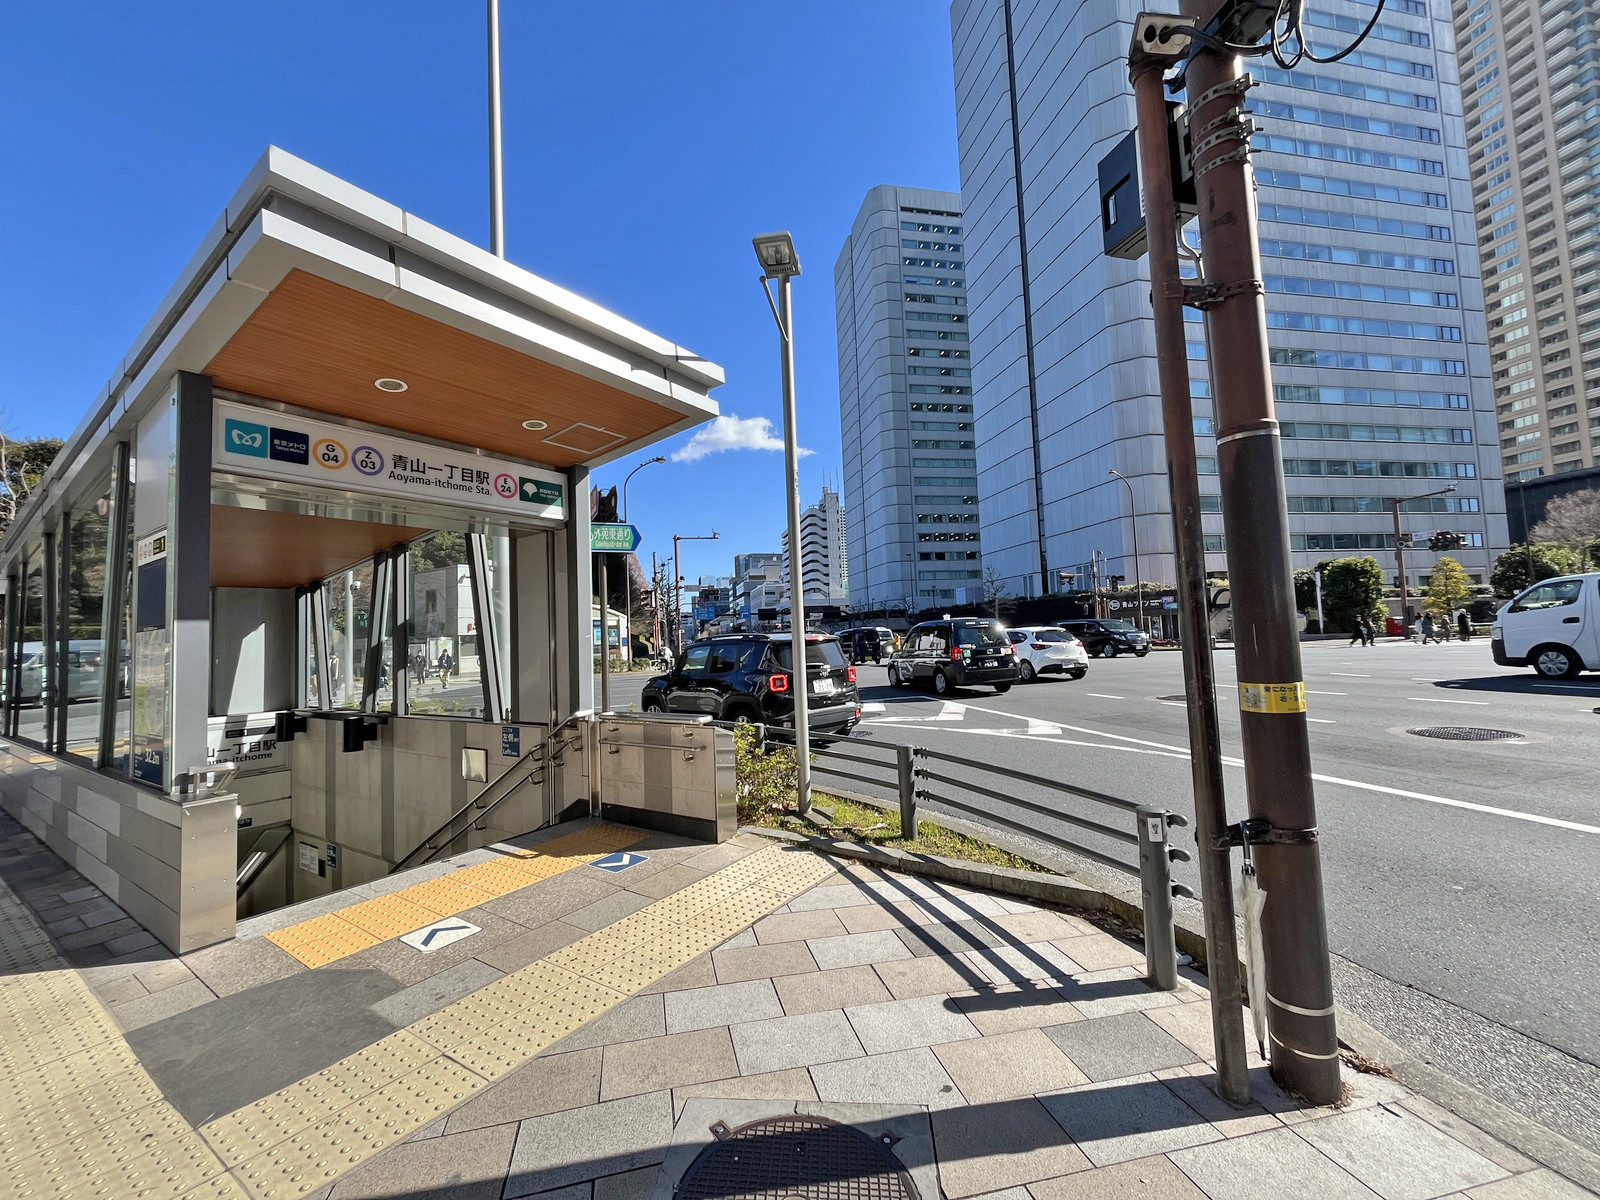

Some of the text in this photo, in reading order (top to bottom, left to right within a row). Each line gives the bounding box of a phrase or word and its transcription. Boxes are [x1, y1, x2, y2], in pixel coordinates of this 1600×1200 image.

[325, 444, 336, 452] G
[322, 453, 339, 463] 04
[365, 451, 372, 459] Z
[360, 460, 376, 470] 03
[392, 454, 490, 486] 青山一丁目駅
[388, 470, 493, 496] Aoyama-itchome Sta.
[500, 485, 512, 493] 24
